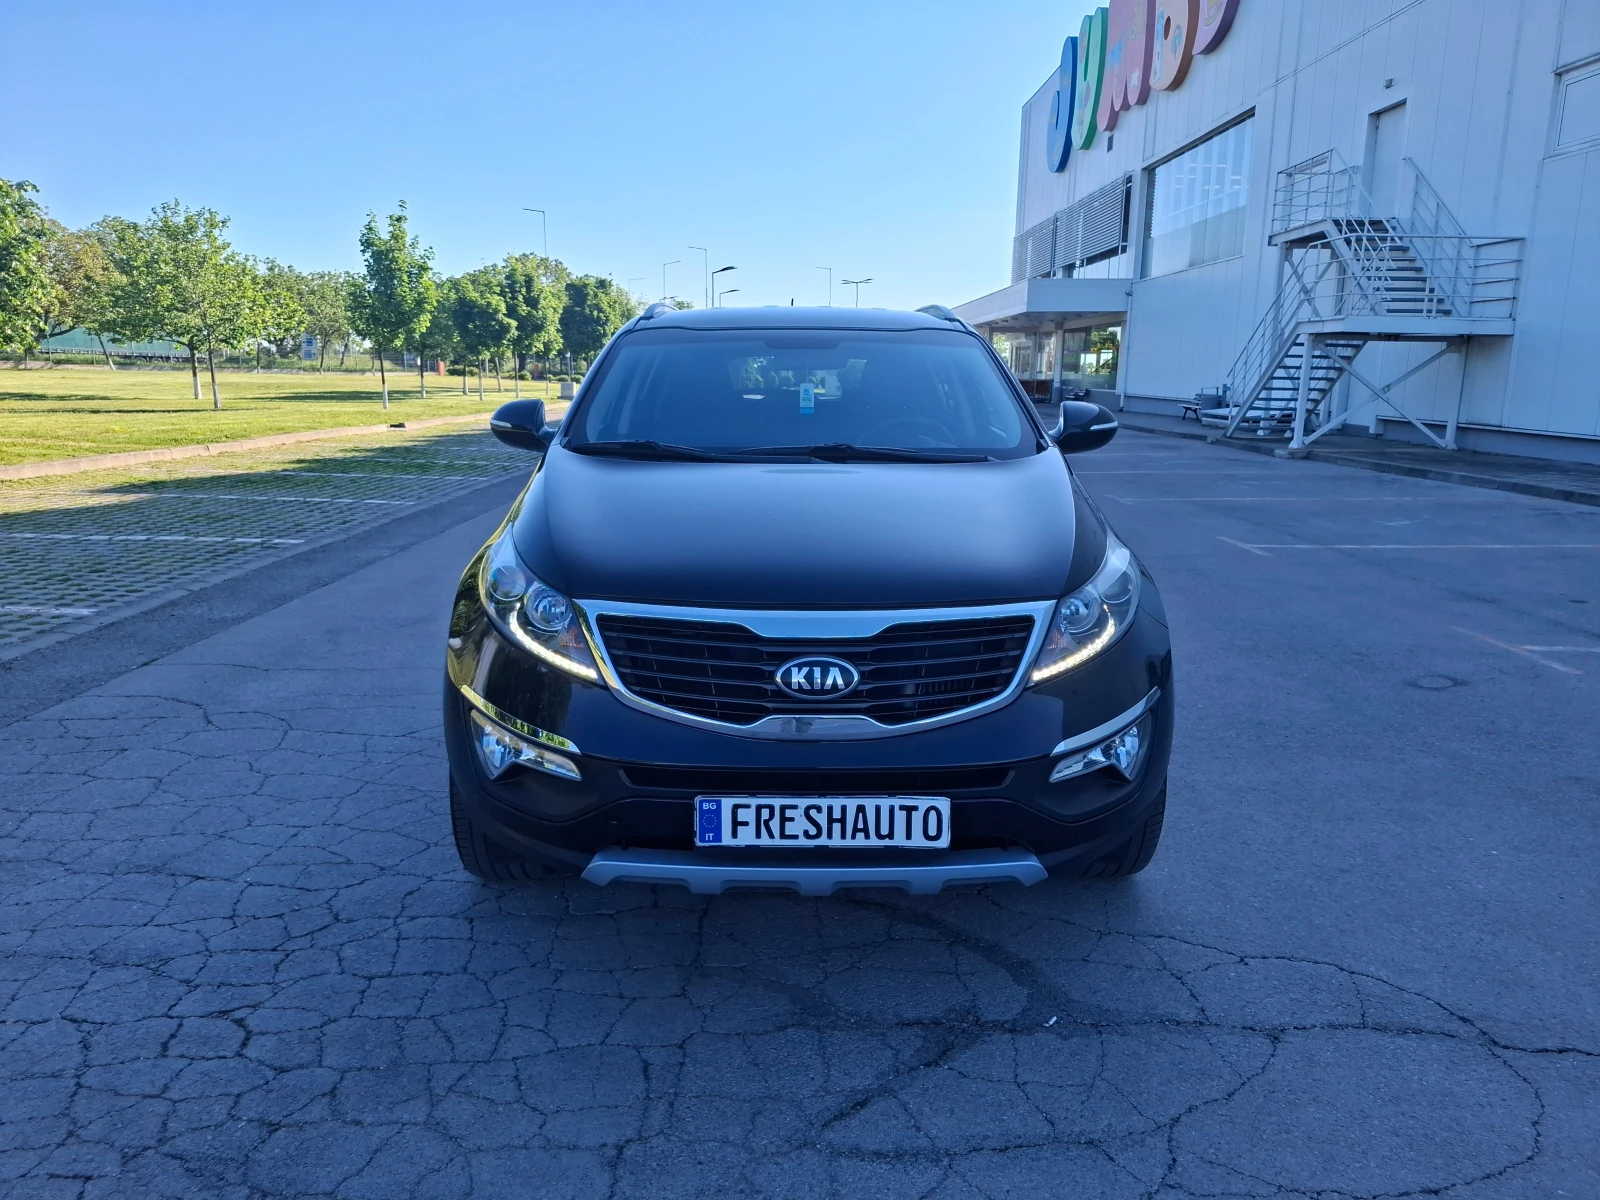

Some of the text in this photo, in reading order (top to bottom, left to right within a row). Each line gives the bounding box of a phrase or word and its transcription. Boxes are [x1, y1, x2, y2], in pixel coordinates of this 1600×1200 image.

[791, 667, 845, 690] KIA
[702, 802, 717, 810] BG
[731, 803, 944, 842] FRESHAUTO
[705, 833, 715, 841] IT
